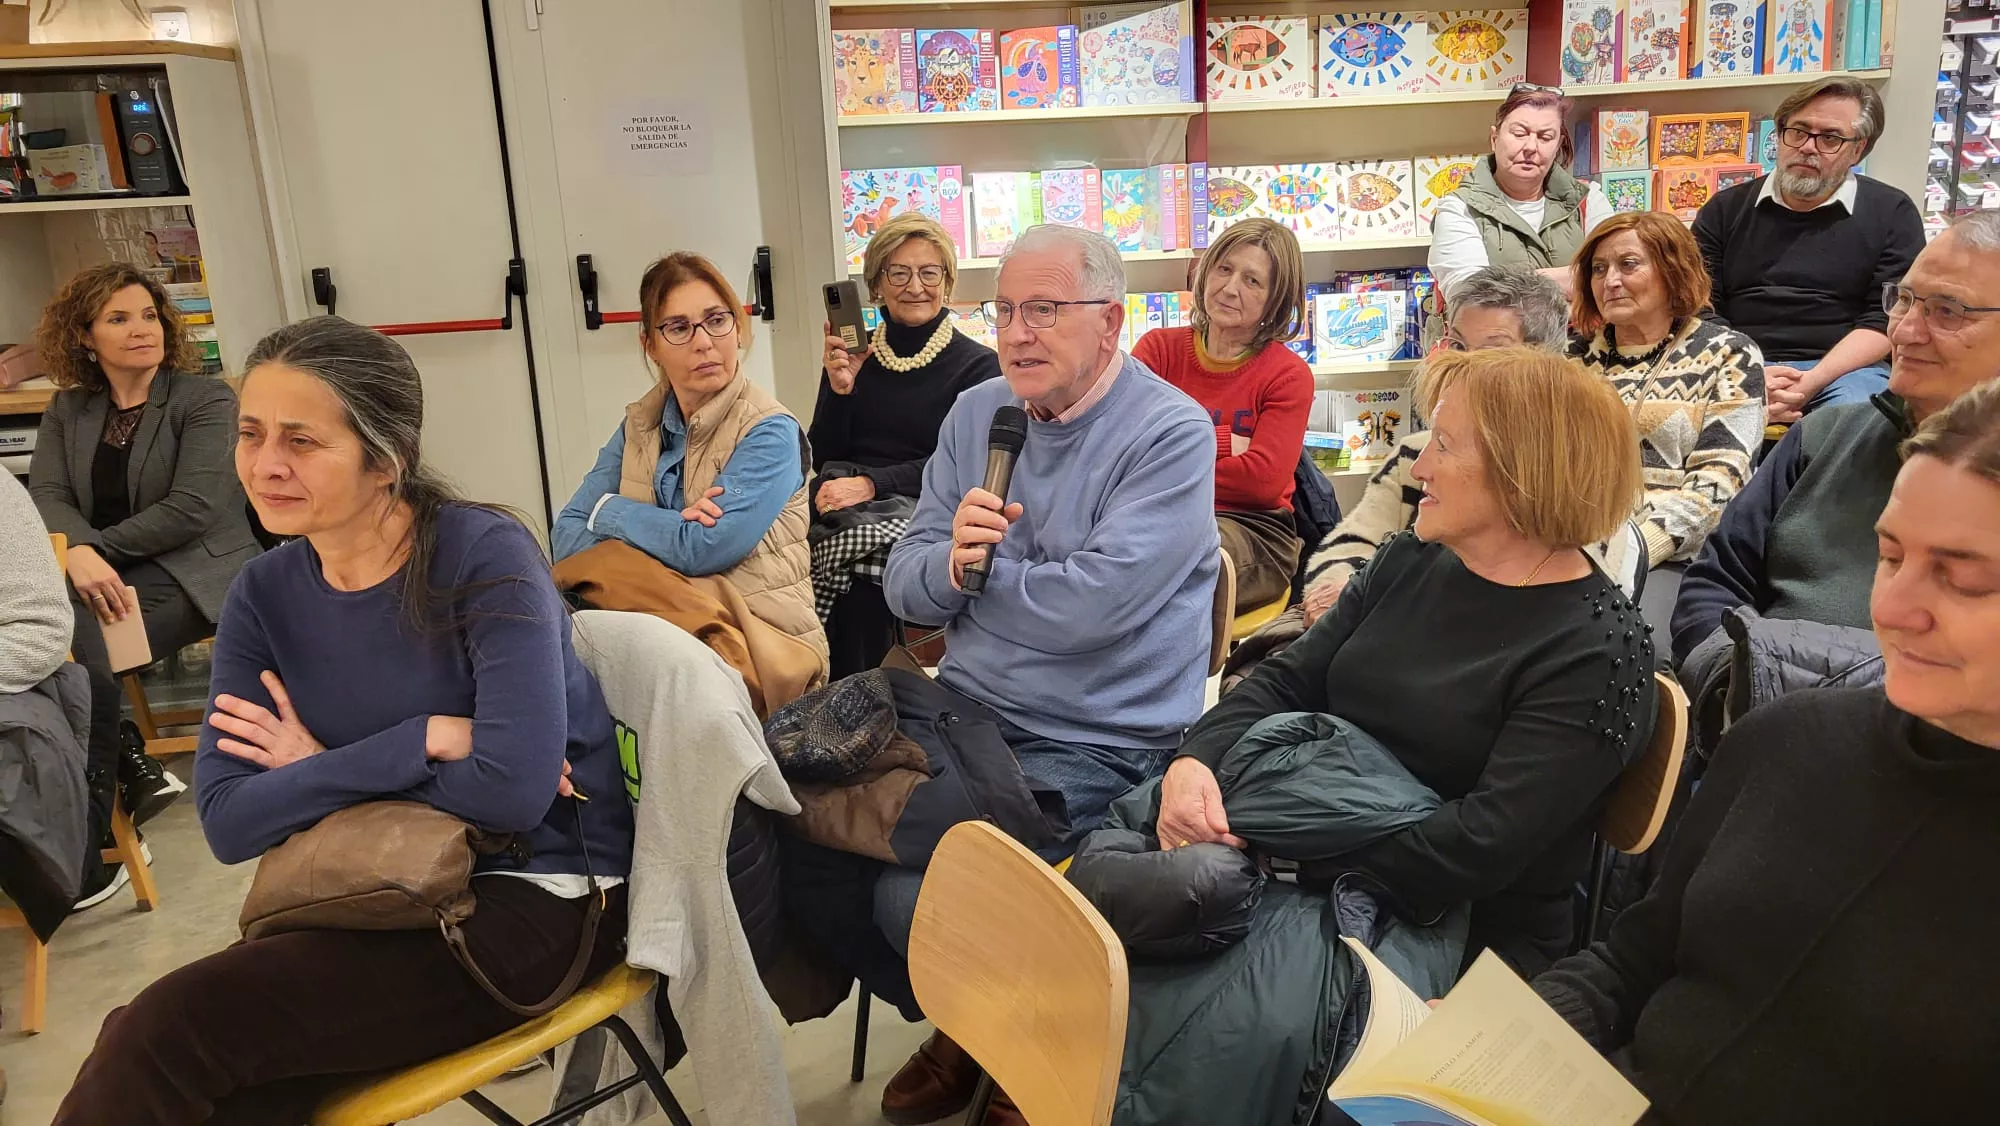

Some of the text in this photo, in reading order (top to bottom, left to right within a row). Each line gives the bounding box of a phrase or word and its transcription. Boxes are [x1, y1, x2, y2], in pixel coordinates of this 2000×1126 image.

[649, 115, 679, 124] FAVOR,
[636, 124, 679, 133] BLOQUEAR
[681, 123, 692, 131] LA
[638, 133, 667, 141] SALIDA
[631, 141, 688, 150] EMERGENCIAS
